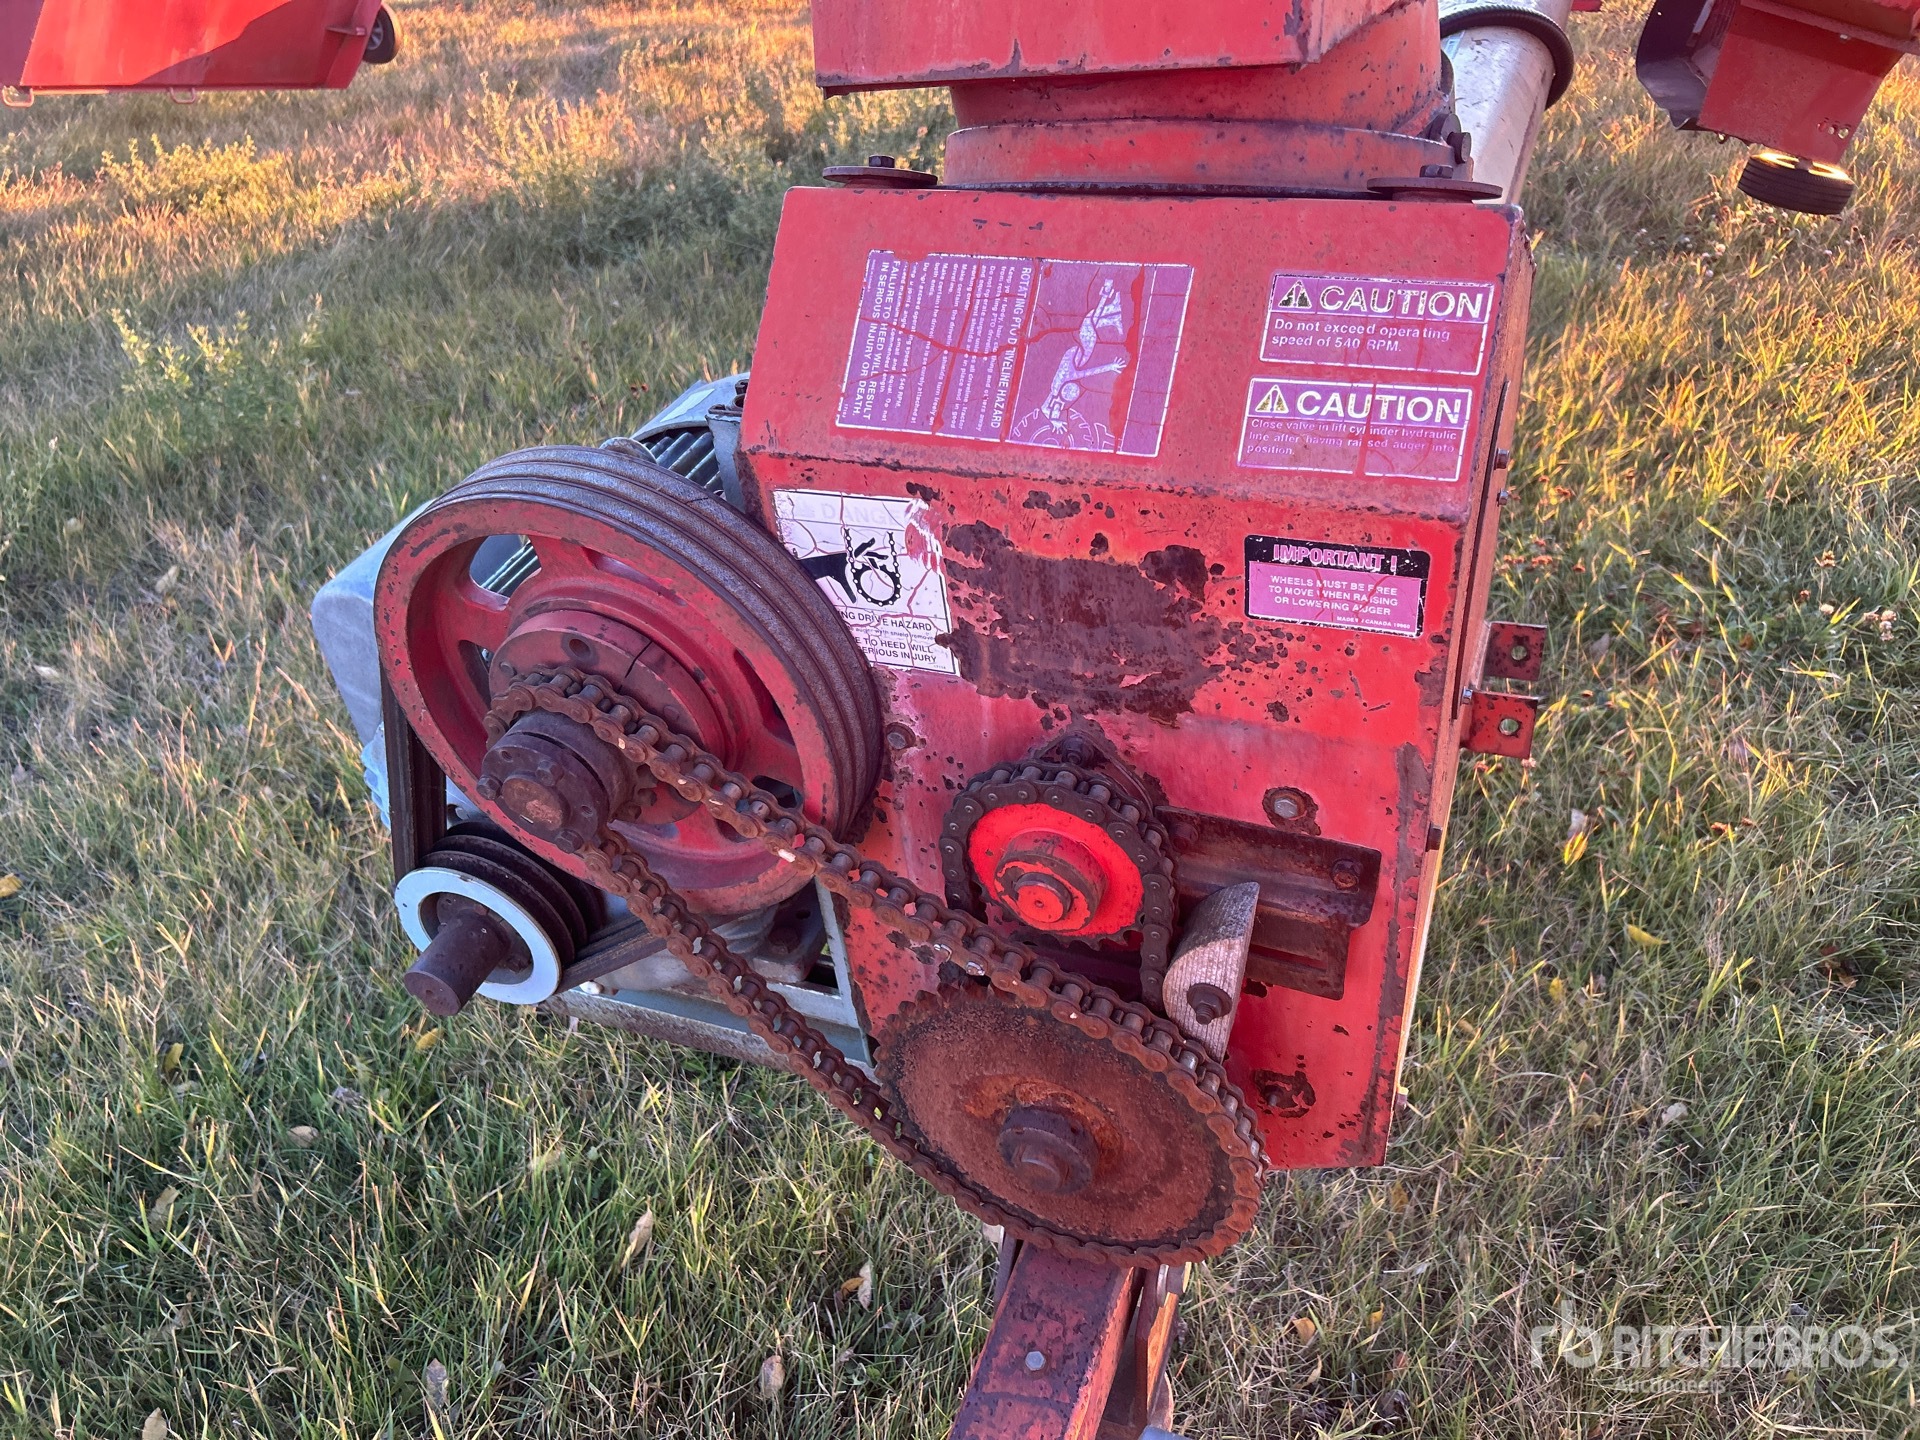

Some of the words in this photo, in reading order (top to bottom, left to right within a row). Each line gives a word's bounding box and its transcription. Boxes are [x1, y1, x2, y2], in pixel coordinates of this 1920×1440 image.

[880, 262, 889, 271] IN
[939, 262, 948, 280] Make
[958, 263, 967, 281] Make
[988, 265, 995, 274] Do
[1005, 266, 1015, 283] Keep
[884, 260, 900, 303] FAILURE
[1013, 267, 1031, 314] ROTATING
[871, 274, 887, 318] SERIOUS
[934, 281, 944, 304] certain
[953, 283, 962, 306] certain
[972, 279, 983, 316] equipment
[980, 288, 989, 316] operate
[991, 283, 1002, 311] rotating
[1318, 284, 1483, 318] CAUTION
[882, 305, 891, 318] TO
[875, 322, 888, 349] HEED
[967, 318, 976, 342] shields
[975, 317, 984, 336] auger
[1274, 318, 1293, 330] Do
[1296, 320, 1320, 331] not
[1324, 321, 1375, 335] exceed
[1378, 324, 1450, 342] operating
[863, 323, 877, 359] INJURY
[1271, 333, 1312, 348] speed
[1316, 336, 1331, 347] of
[1334, 336, 1360, 349] 540
[1365, 338, 1403, 352] RPM.
[870, 352, 882, 376] WILL
[902, 346, 911, 366] speed
[860, 361, 869, 376] OR
[900, 367, 907, 376] of
[917, 357, 928, 386] securely
[938, 356, 947, 379] shields
[957, 368, 966, 386] place
[852, 380, 866, 416] DEATH.
[862, 380, 876, 419] RESULT
[883, 398, 891, 407] Do
[912, 386, 923, 415] attached
[929, 396, 939, 414] freely
[990, 389, 1006, 428] HAZARD
[1295, 390, 1461, 423] CAUTION
[928, 416, 934, 425] on
[949, 411, 958, 428] good
[958, 406, 967, 429] tractor
[975, 414, 984, 431] away
[1251, 418, 1282, 429] Close
[1286, 421, 1315, 430] valve
[1348, 425, 1398, 437] cylinder
[1401, 428, 1457, 441] hydraulic
[1246, 444, 1295, 456] position.
[1248, 431, 1270, 440] line
[1274, 433, 1299, 442] after
[1305, 436, 1342, 447] having
[1347, 437, 1388, 448] raised
[1392, 441, 1425, 451] auger
[1431, 444, 1454, 452] into
[1273, 543, 1384, 570] IMPORTANT
[1268, 585, 1281, 593] TO
[1284, 586, 1313, 596] MOVE
[1316, 589, 1350, 599] WHEN
[1353, 593, 1398, 606] RAISING
[1270, 575, 1313, 586] WHEELS
[1316, 579, 1347, 589] MUST
[1350, 582, 1364, 591] BE
[1367, 584, 1397, 595] FREE
[1274, 595, 1289, 604] OR
[1292, 597, 1349, 610] LOWERING
[1352, 603, 1390, 615] AUGER
[858, 613, 889, 626] DRIVE
[891, 620, 932, 631] HAZARD
[863, 638, 878, 646] TO
[881, 640, 906, 649] HEED
[911, 644, 933, 653] WILL
[901, 652, 936, 662] INJURY
